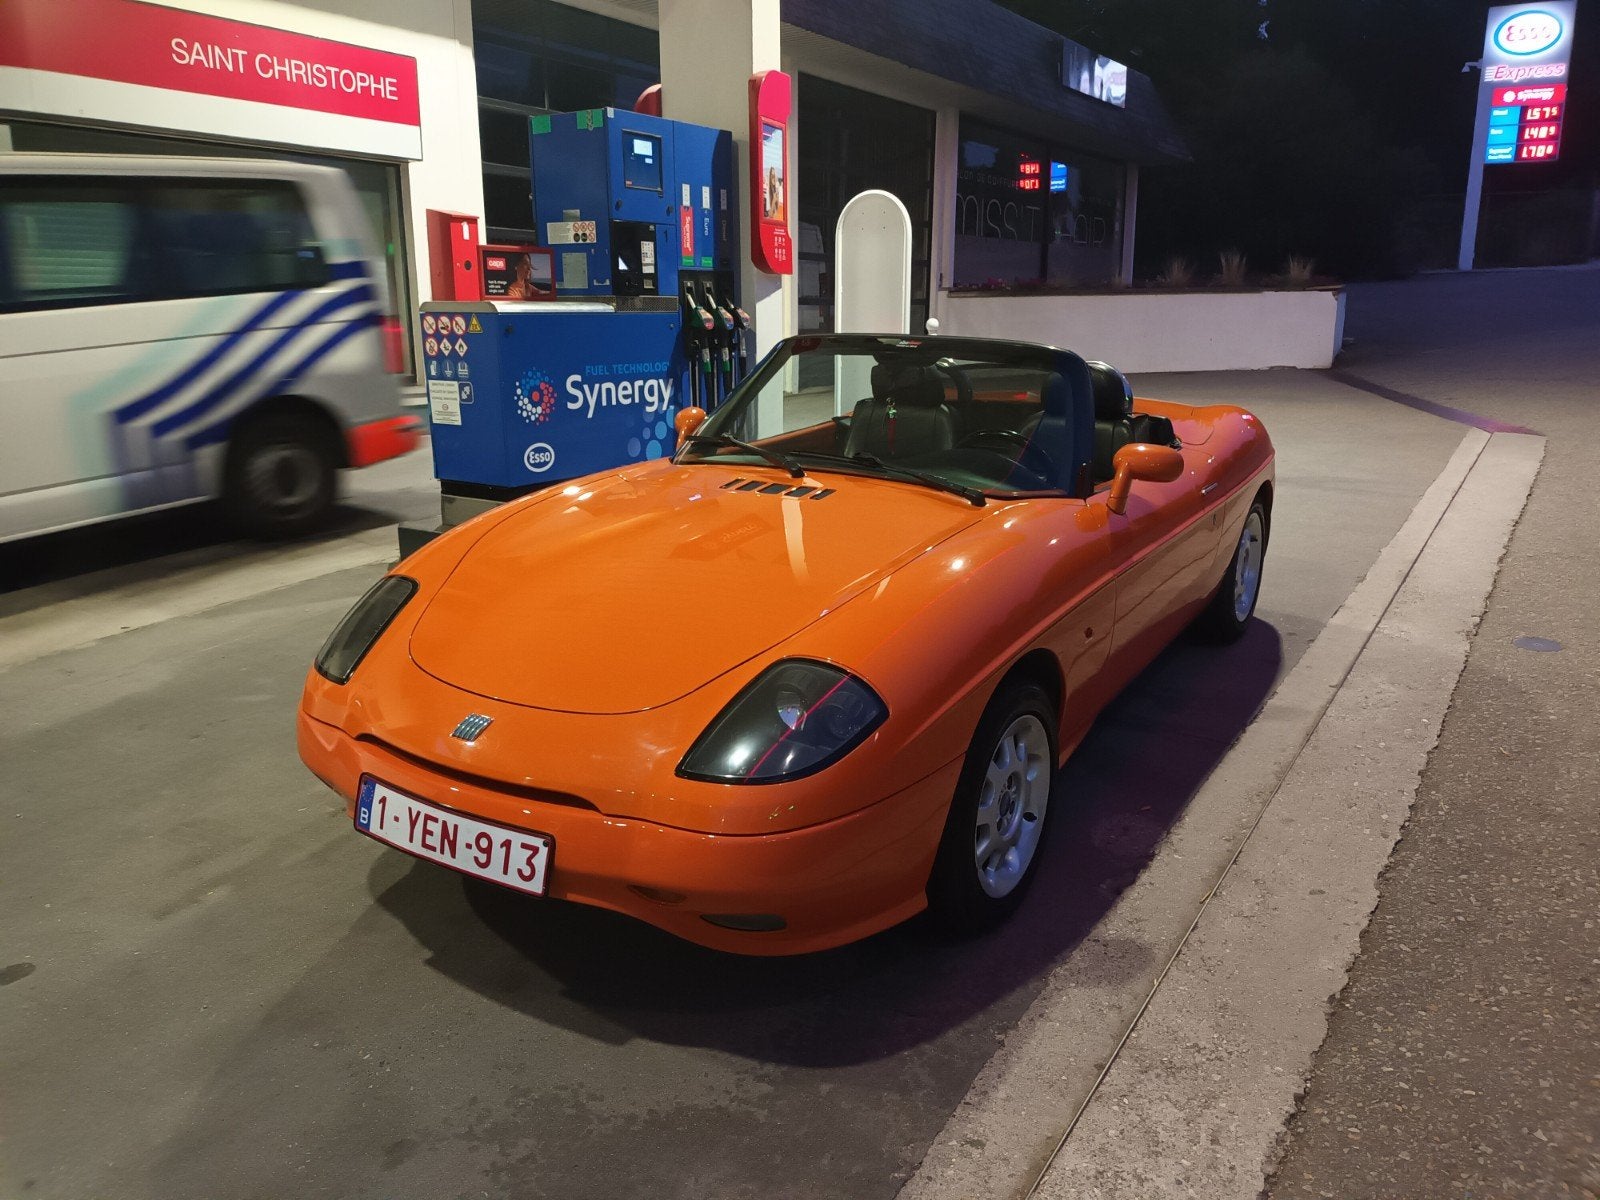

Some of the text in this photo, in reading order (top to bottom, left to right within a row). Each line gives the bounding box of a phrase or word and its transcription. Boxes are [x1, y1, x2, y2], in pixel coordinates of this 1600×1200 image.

[171, 38, 399, 101] SAINT CHRISTOPHE
[1494, 63, 1566, 82] Express
[585, 365, 610, 376] FUEL
[565, 374, 674, 419] Synergy
[529, 451, 550, 464] Esso
[359, 807, 369, 825] B
[378, 795, 541, 883] 1-YEN-913
